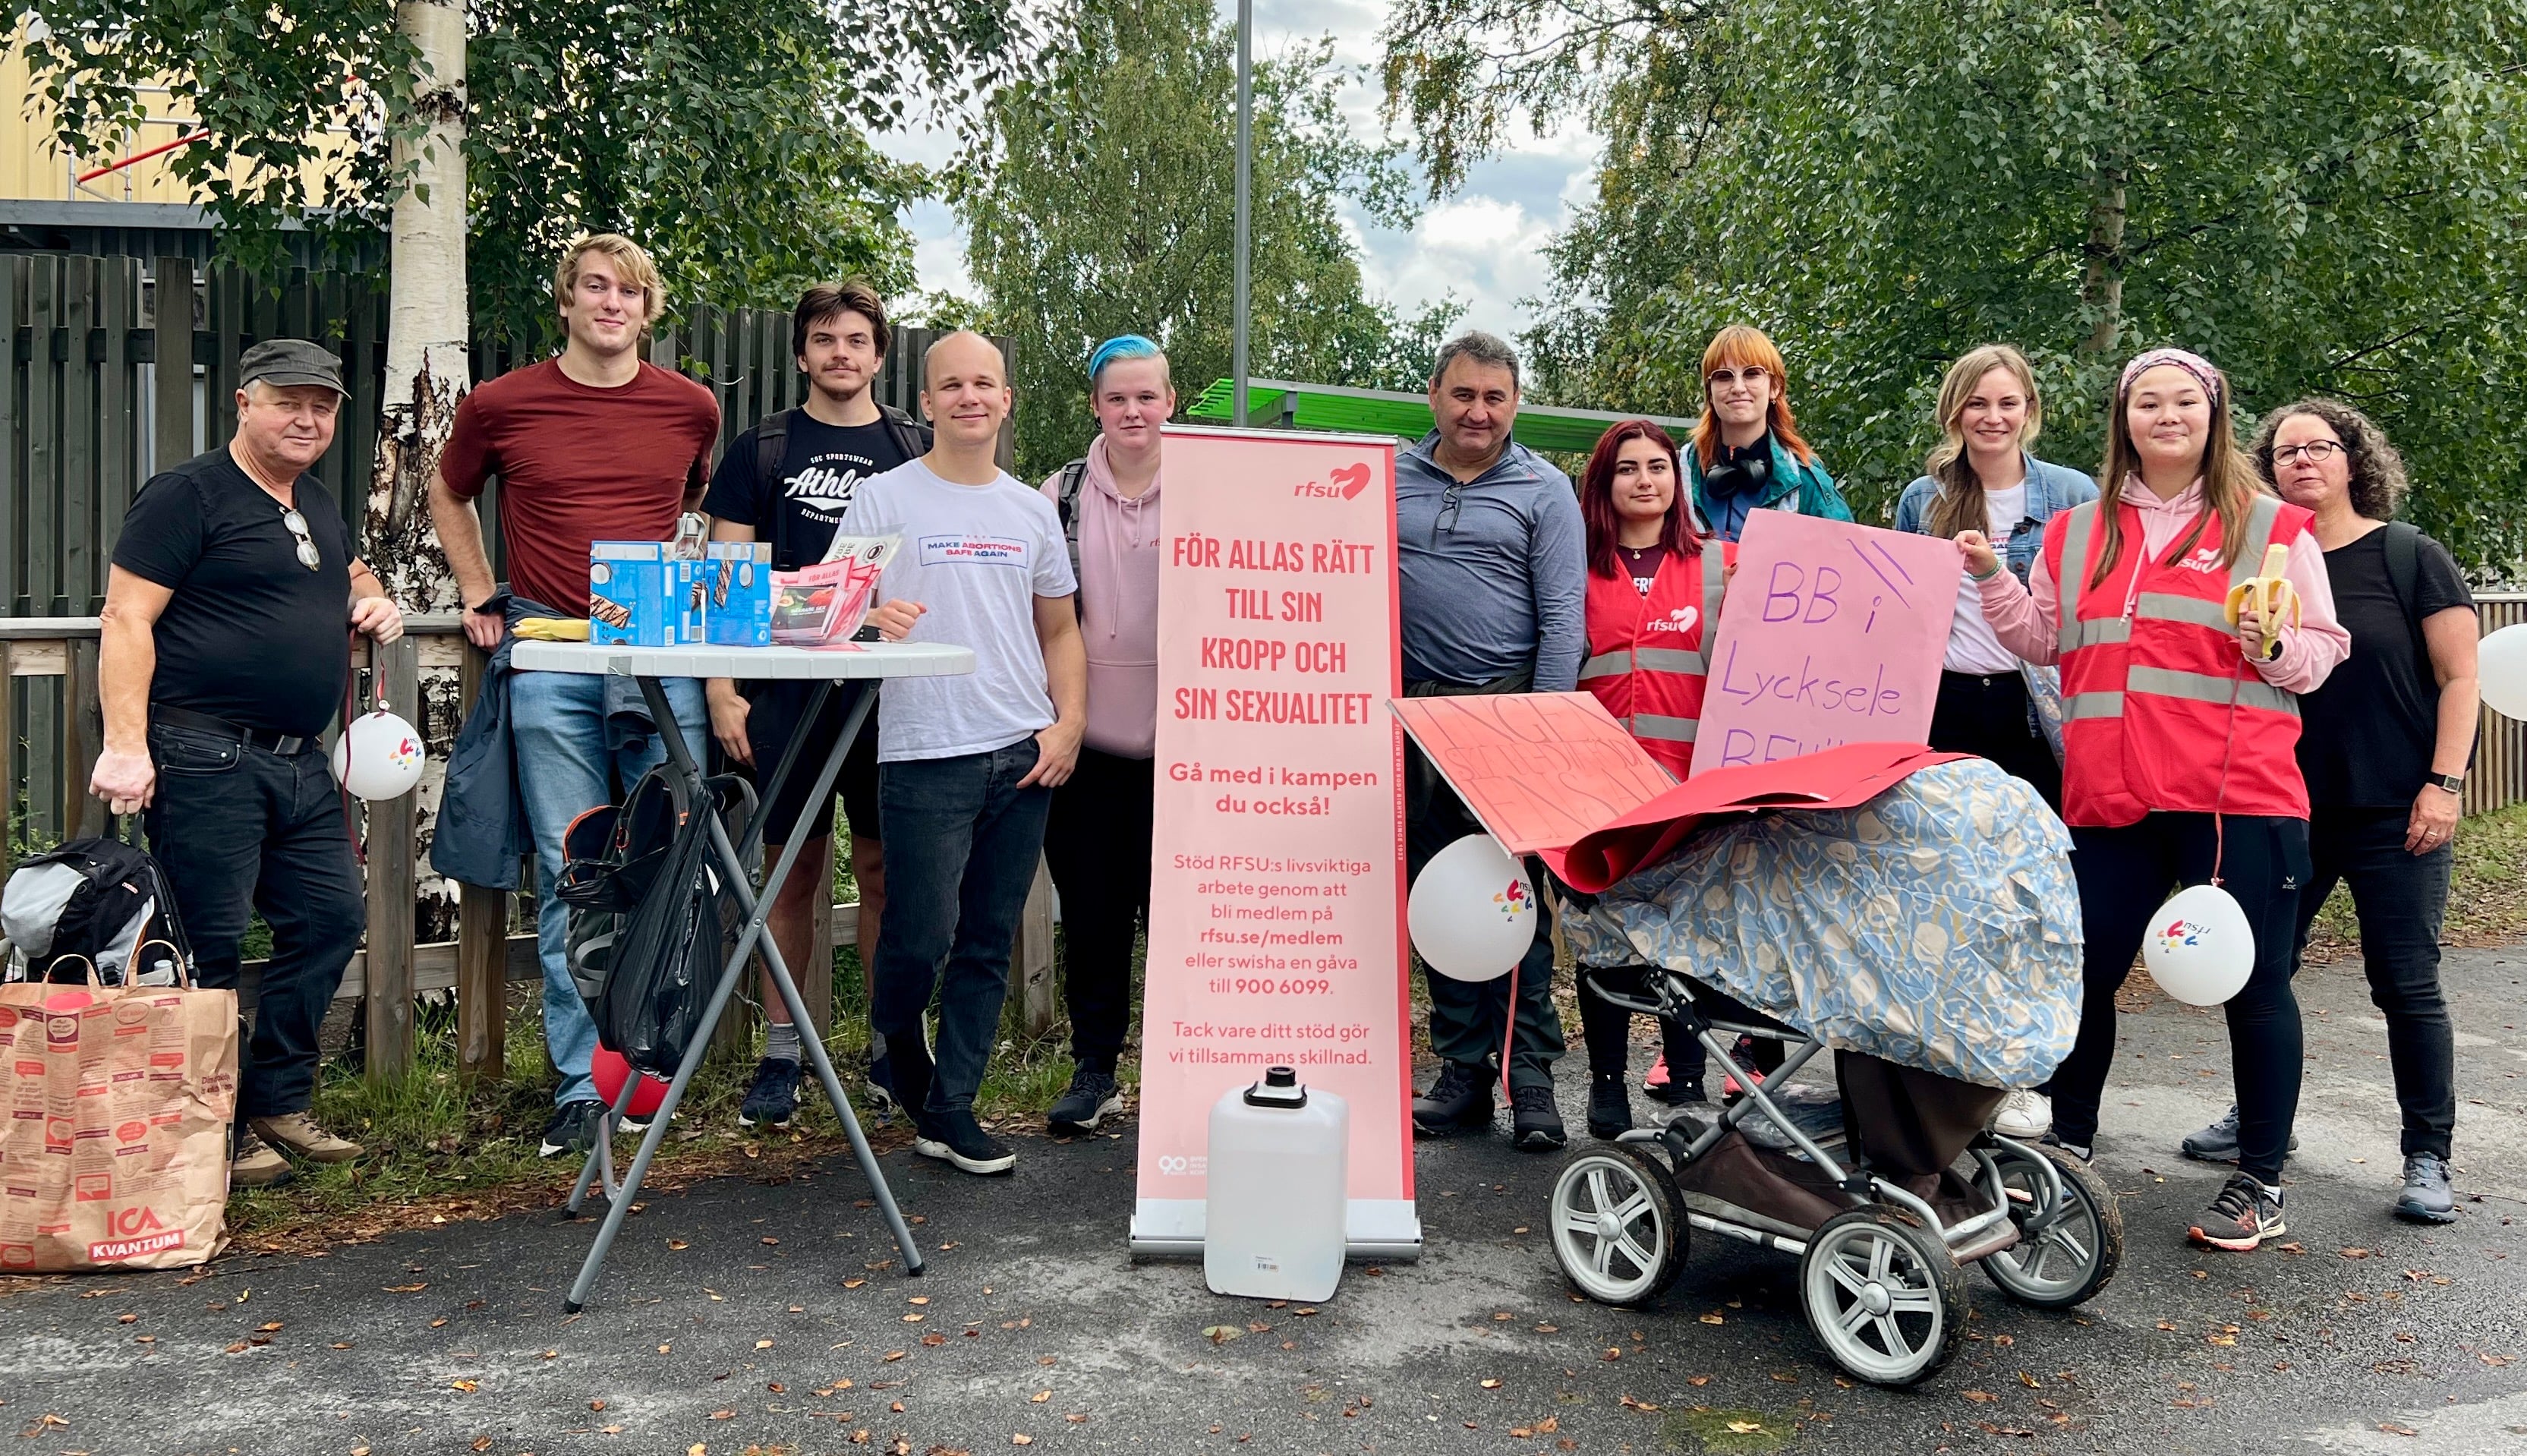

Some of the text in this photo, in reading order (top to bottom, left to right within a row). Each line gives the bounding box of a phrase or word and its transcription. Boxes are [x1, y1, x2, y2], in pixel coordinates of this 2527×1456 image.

[826, 454, 873, 466] SPORTSWEAR
[1293, 481, 1340, 498] rfsu
[801, 509, 842, 524] DEPARTME
[962, 542, 1022, 553] ABORTIONS
[1174, 533, 1374, 574] FÖR ALLAS RÄTT
[1226, 588, 1321, 622] TILL SIN
[1763, 561, 1883, 633] BB i
[1646, 619, 1678, 631] rfsu
[1202, 638, 1345, 673] KROPP OCH
[1722, 640, 1901, 717] Lycksele
[1175, 688, 1372, 724] SIN SEXUALITET
[1170, 762, 1376, 790] Gå med i kampen
[1216, 794, 1329, 815] du också!
[1174, 855, 1370, 876] Stöd RFSU:s livsviktiga
[1198, 880, 1347, 899] arbete genom att
[1212, 904, 1332, 924] bli medlem på
[1201, 928, 1342, 947] rfsu.se/medlem
[2184, 922, 2211, 934] rfsu
[1186, 953, 1356, 973] eller swisha en gåva
[1209, 979, 1333, 994] till 900 6099.
[1173, 1022, 1369, 1042] Tack vare ditt stöd gör
[1170, 1048, 1372, 1064] vi tillsammans skillnad.
[107, 1206, 163, 1237] ICA
[93, 1233, 179, 1258] KVANTUM
